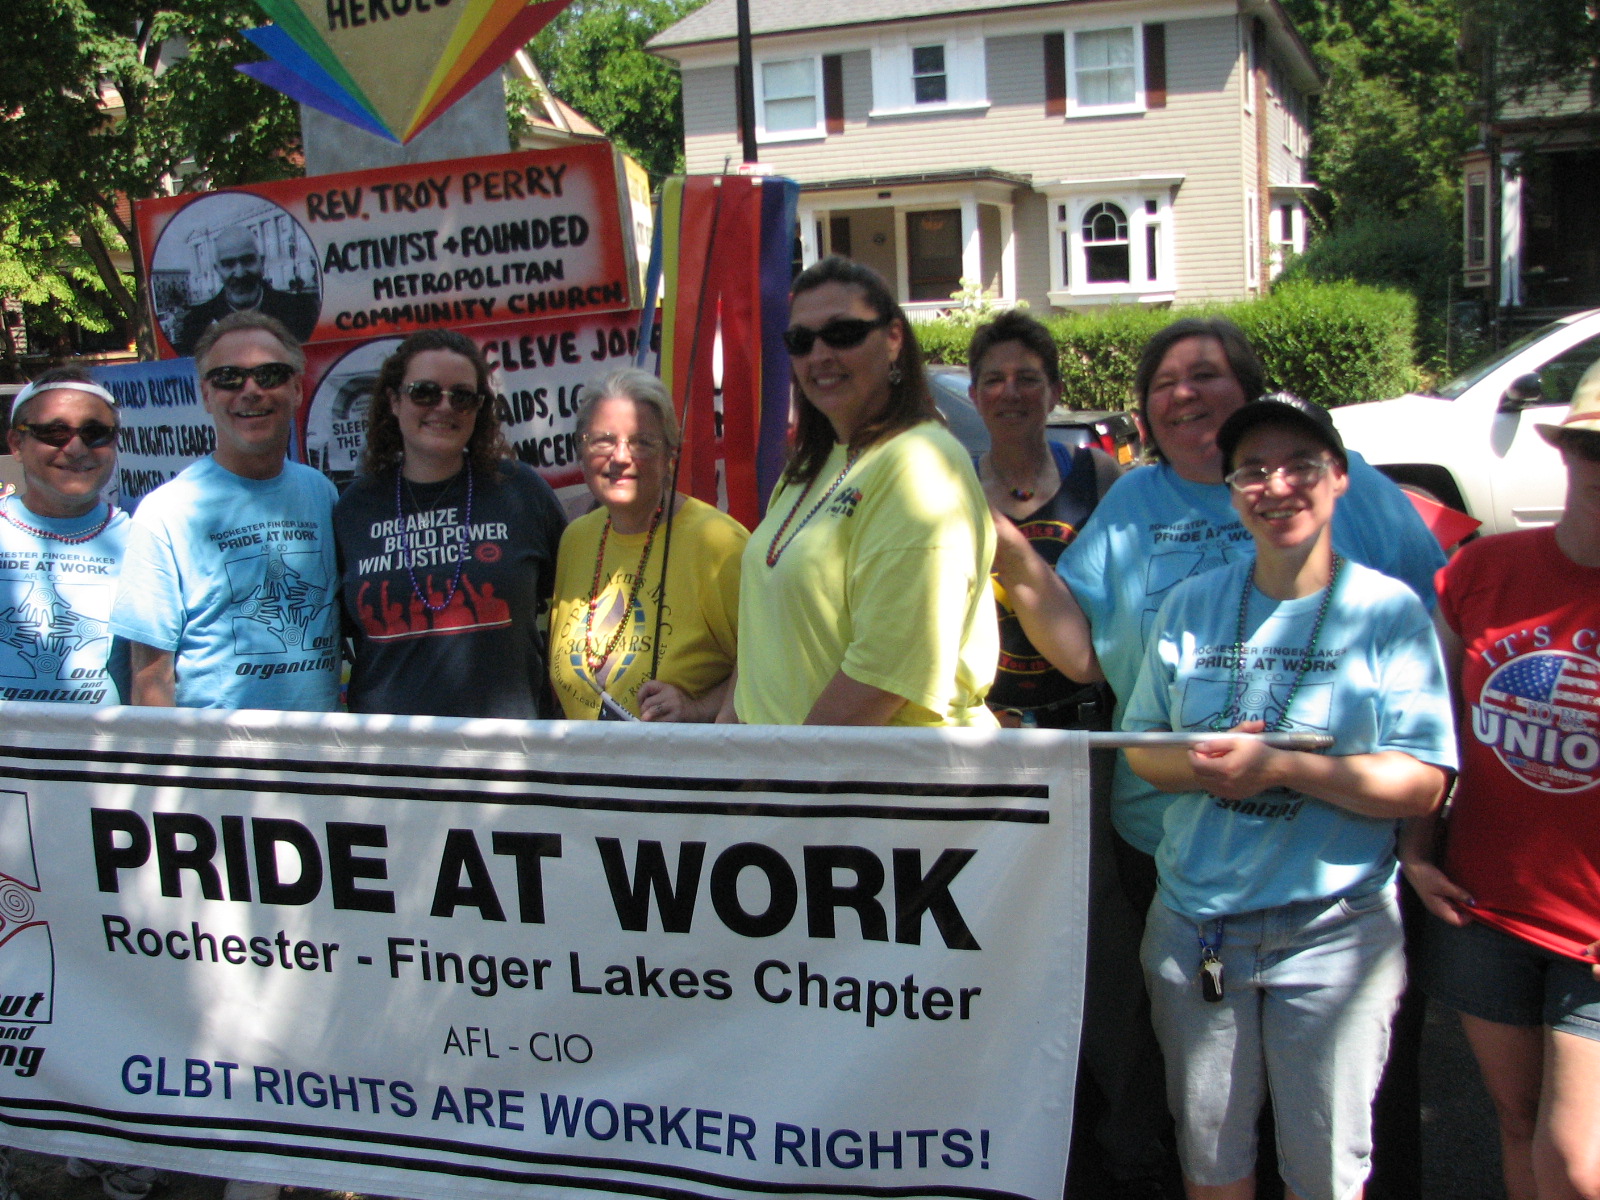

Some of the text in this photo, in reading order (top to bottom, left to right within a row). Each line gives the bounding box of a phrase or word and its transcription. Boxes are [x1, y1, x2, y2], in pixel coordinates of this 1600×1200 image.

[306, 163, 567, 221] REV. TROY PERRY
[323, 229, 438, 274] ACTIVIST
[373, 258, 564, 300] METROPOLITAN
[335, 281, 625, 331] COMMUNITY CHURCH
[482, 330, 582, 373] CLEVE
[148, 375, 198, 408] RUSTIN
[496, 387, 554, 428] AIDS,
[138, 424, 175, 457] RIGHTS
[175, 423, 217, 458] LEADER
[337, 434, 361, 450] THE
[209, 522, 266, 542] ROCHESTER
[371, 508, 458, 538] ORGANIZE
[385, 523, 508, 553] BUILD POWER
[218, 530, 319, 552] PRIDE AT WORK
[35, 561, 55, 572] AT
[60, 562, 110, 575] WORK
[42, 553, 81, 561] FINGER
[83, 555, 116, 565] LAKES
[359, 554, 392, 575] WIN
[396, 543, 472, 570] JUSTICE
[1481, 625, 1551, 668] IT'S
[70, 667, 108, 680] Out
[235, 657, 336, 679] Organizing
[1253, 657, 1276, 670] AT
[81, 680, 103, 689] and
[91, 807, 982, 950] PRIDE AT WORK
[102, 915, 339, 973] Rochester
[388, 937, 552, 997] Finger
[570, 952, 733, 1000] Lakes
[753, 959, 982, 1027] Chapter
[443, 1025, 499, 1058] AFL
[529, 1031, 593, 1063] CIO
[122, 1055, 991, 1169] GLBT RIGHTS ARE WORKER RIGHTS!
